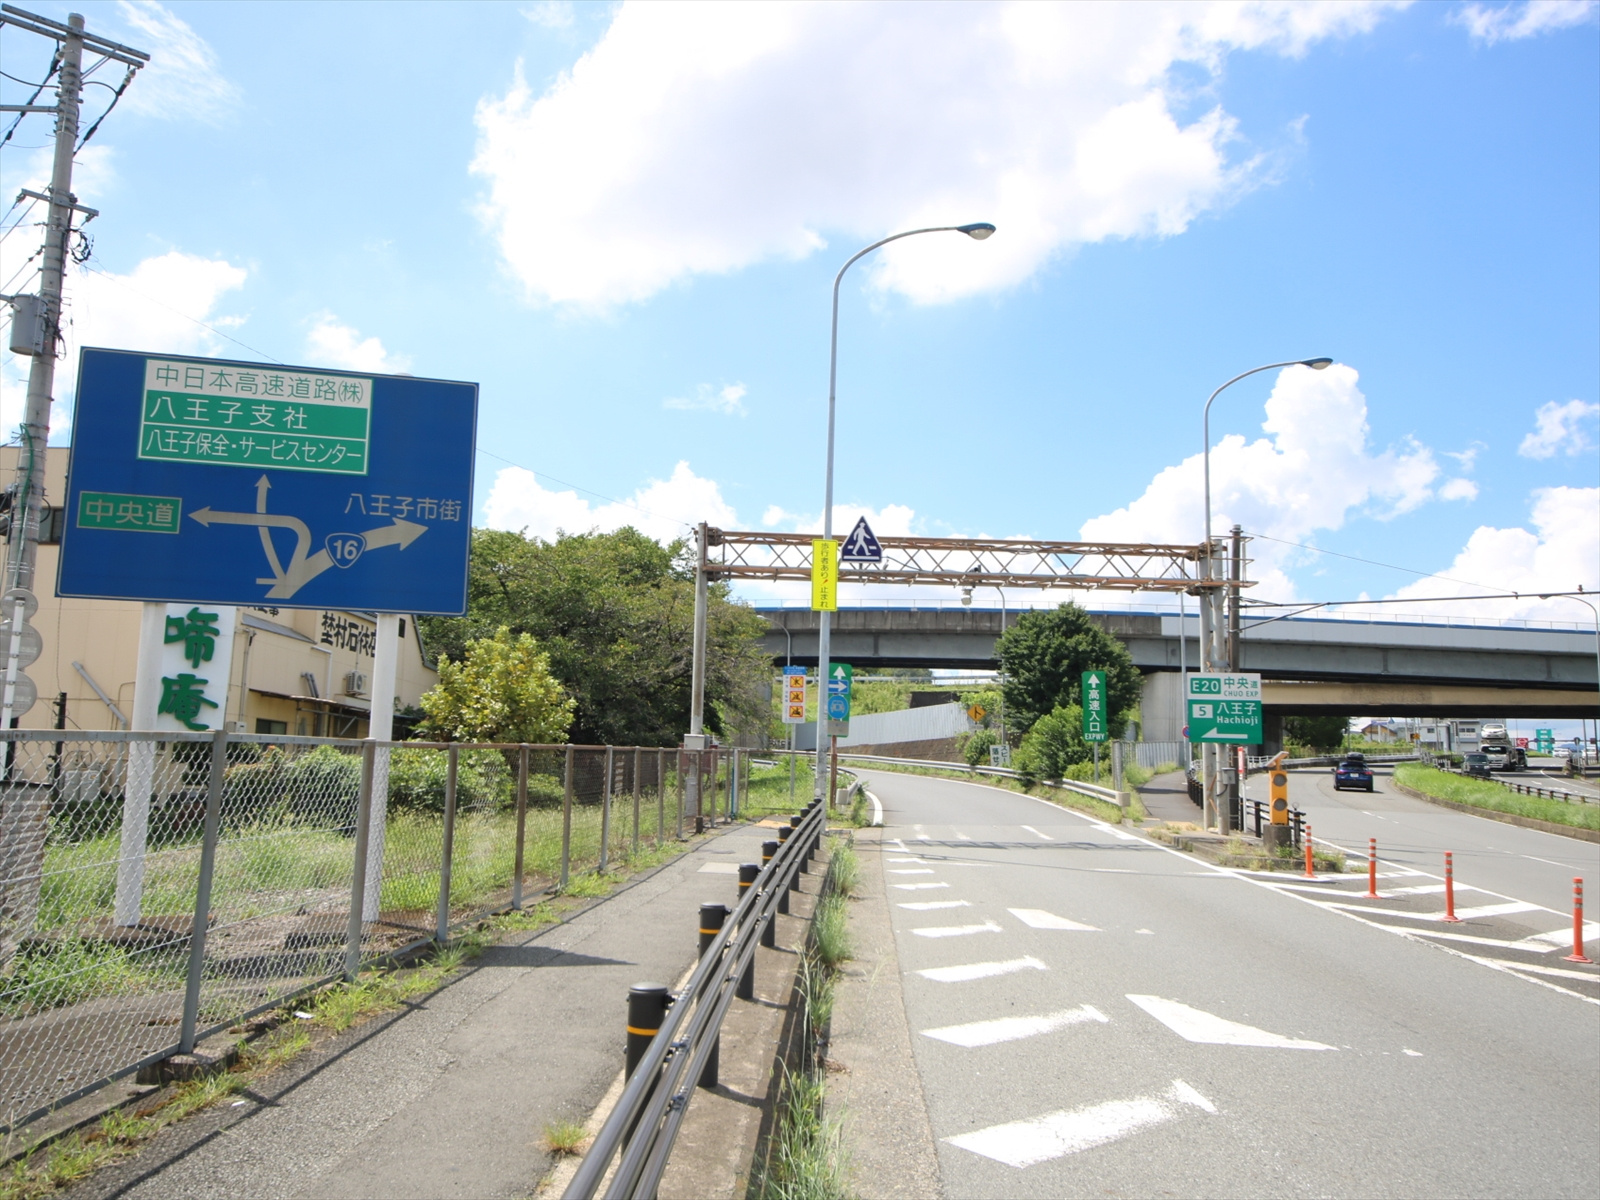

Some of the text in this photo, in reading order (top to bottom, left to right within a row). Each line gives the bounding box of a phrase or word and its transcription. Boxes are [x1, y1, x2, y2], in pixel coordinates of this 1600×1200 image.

[149, 396, 309, 430] 八王子支社
[147, 430, 362, 464] 八王子保全・サービスセンター
[85, 500, 175, 528] 中央道
[344, 492, 462, 522] 八王子市街
[333, 538, 358, 561] 16
[1192, 680, 1219, 692] E20
[1224, 676, 1258, 689] 中央道
[1088, 689, 1100, 732] 高速入口
[1199, 706, 1207, 716] 5
[1217, 702, 1257, 715] 八王子
[1217, 716, 1258, 726] Hachioji
